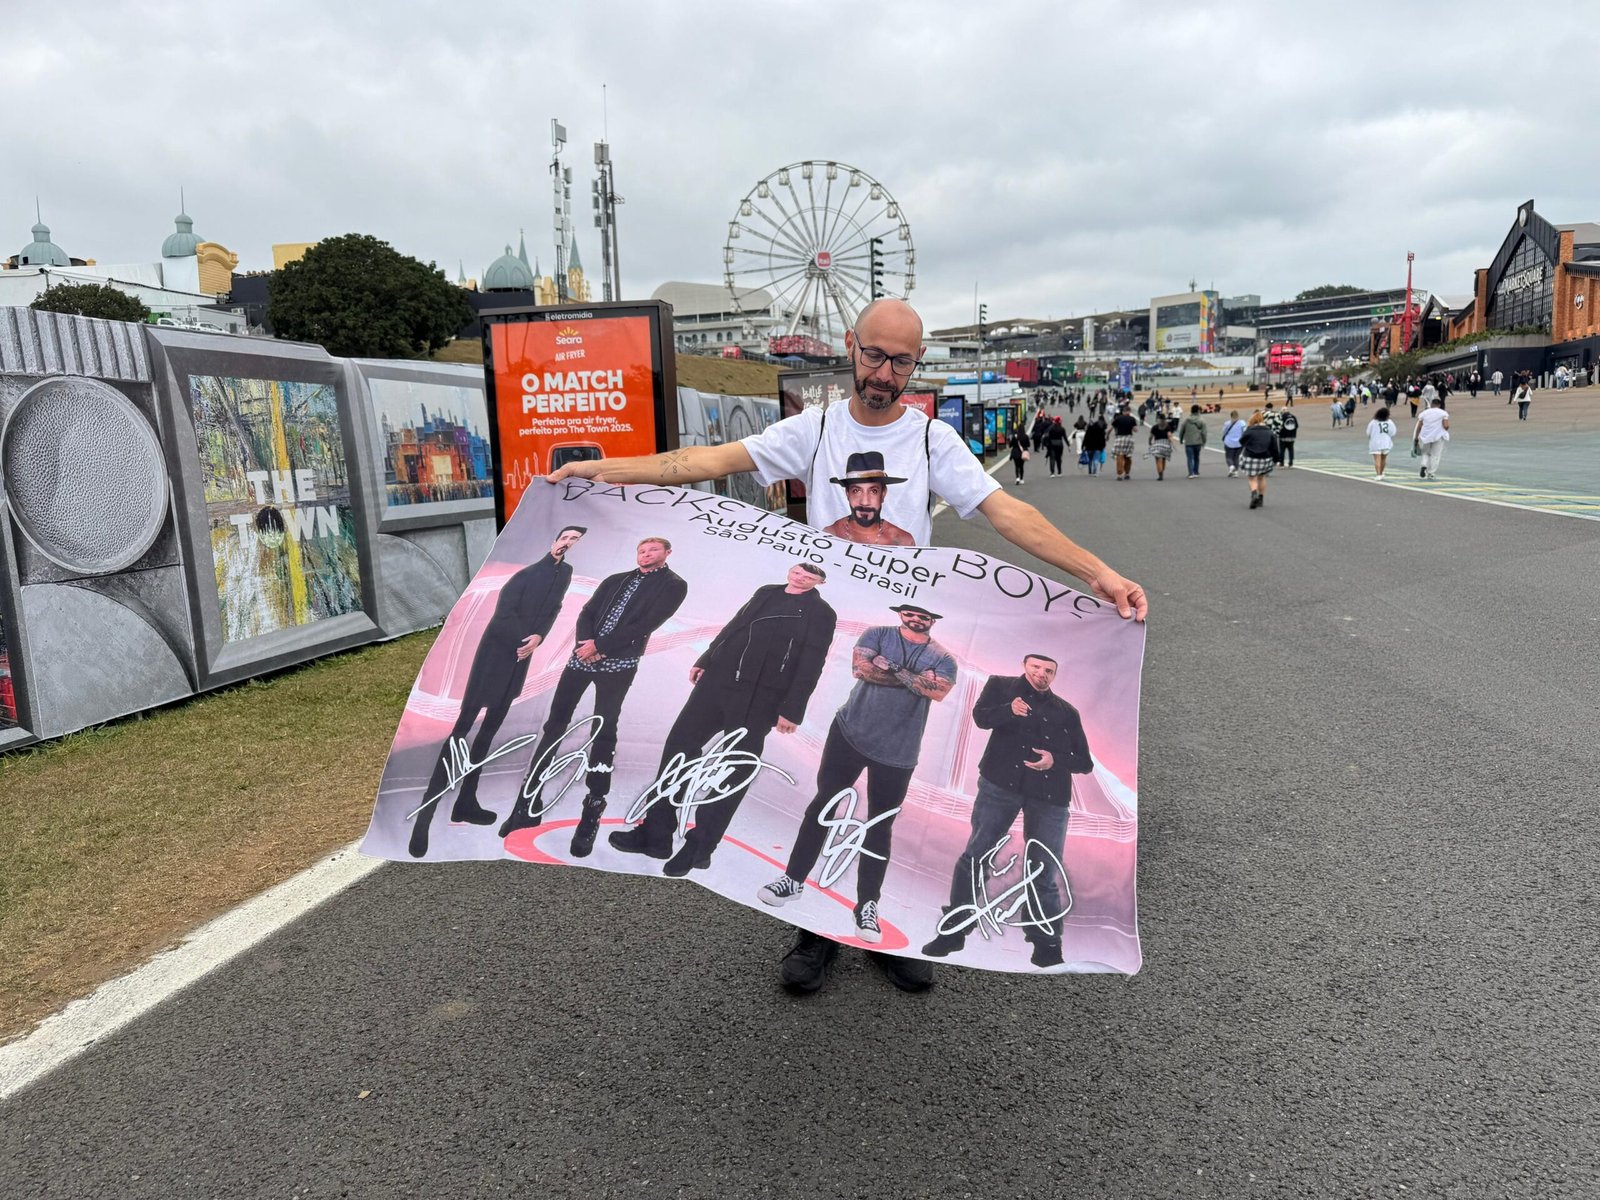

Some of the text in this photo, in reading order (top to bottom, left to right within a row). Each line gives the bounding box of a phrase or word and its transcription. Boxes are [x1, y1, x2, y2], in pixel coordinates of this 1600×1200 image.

[556, 336, 582, 345] Seara
[555, 349, 586, 362] AIR FRYER
[521, 369, 624, 393] O MATCH
[521, 391, 627, 414] PERFEITO
[519, 423, 634, 437] perfeito pro The Town 2025.
[532, 415, 618, 427] Perfeito pra air fryer,
[246, 469, 317, 505] THE
[689, 512, 947, 587] Augusto Luper
[703, 526, 748, 542] São
[757, 536, 825, 564] Paulo
[850, 563, 918, 599] Brasil
